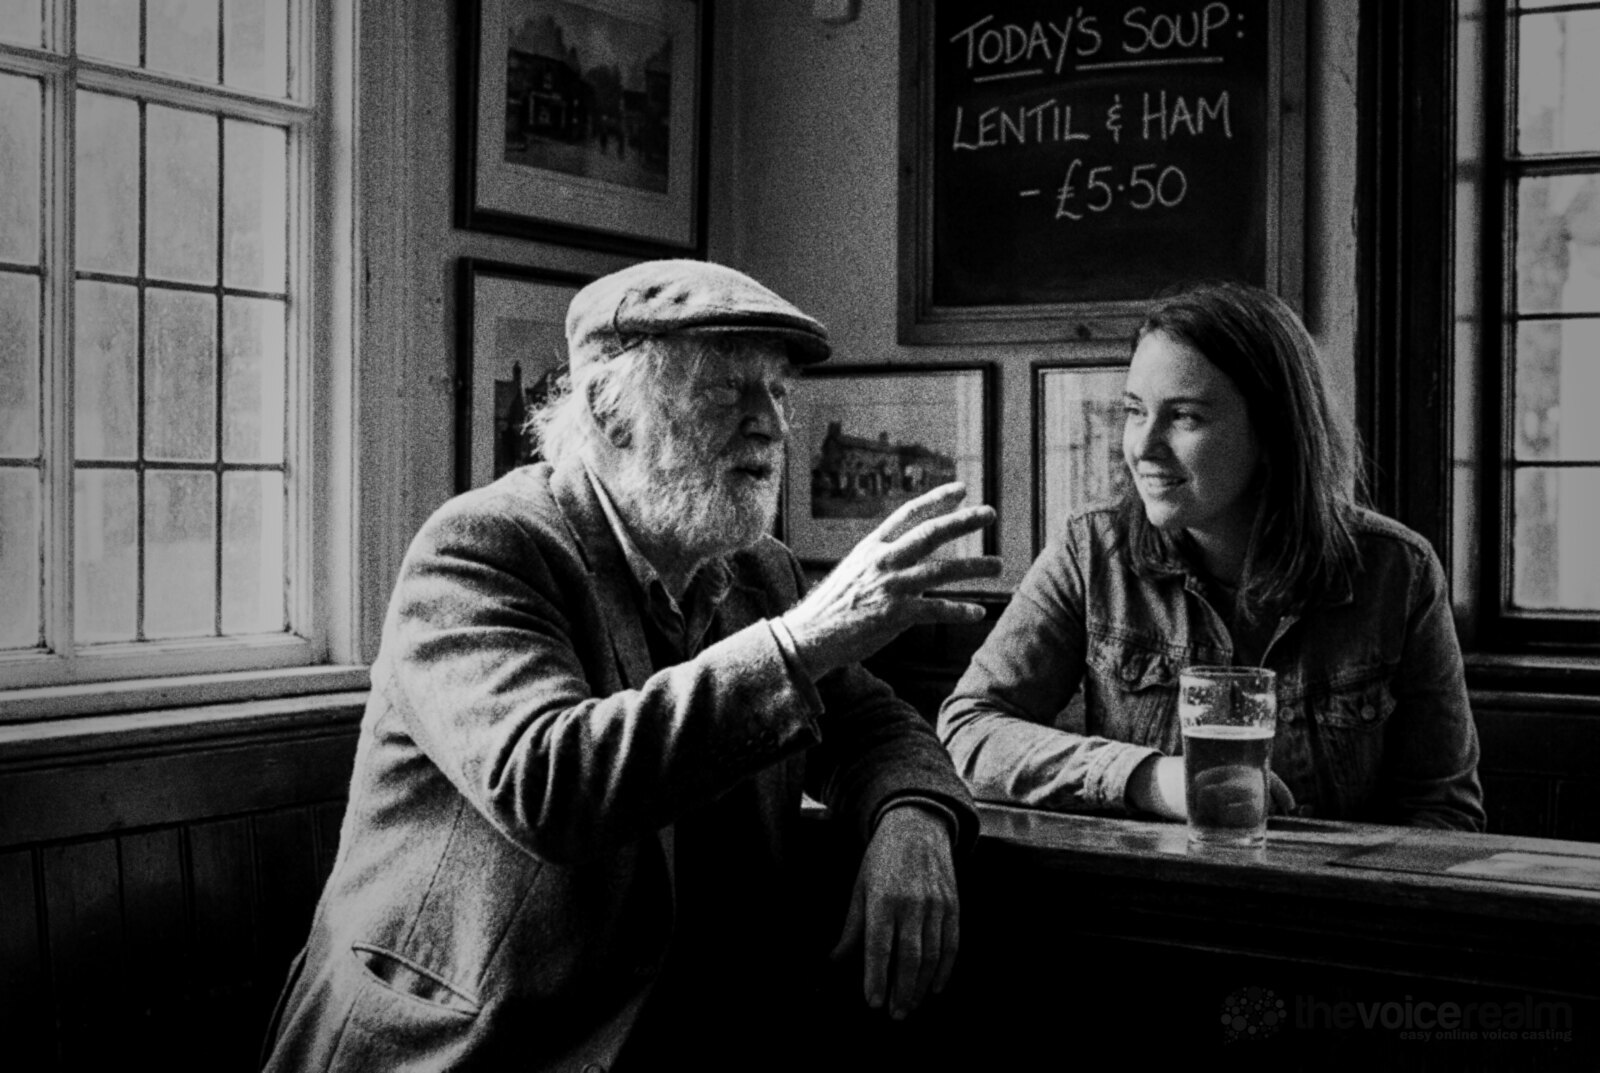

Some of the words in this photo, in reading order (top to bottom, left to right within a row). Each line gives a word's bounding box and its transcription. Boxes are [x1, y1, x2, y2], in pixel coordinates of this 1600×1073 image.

[950, 6, 1102, 75] TODAY'S
[1122, 2, 1245, 53] SOUP:
[953, 98, 1091, 150] LENTIL
[1105, 94, 1123, 144] &
[1142, 90, 1232, 141] HAM
